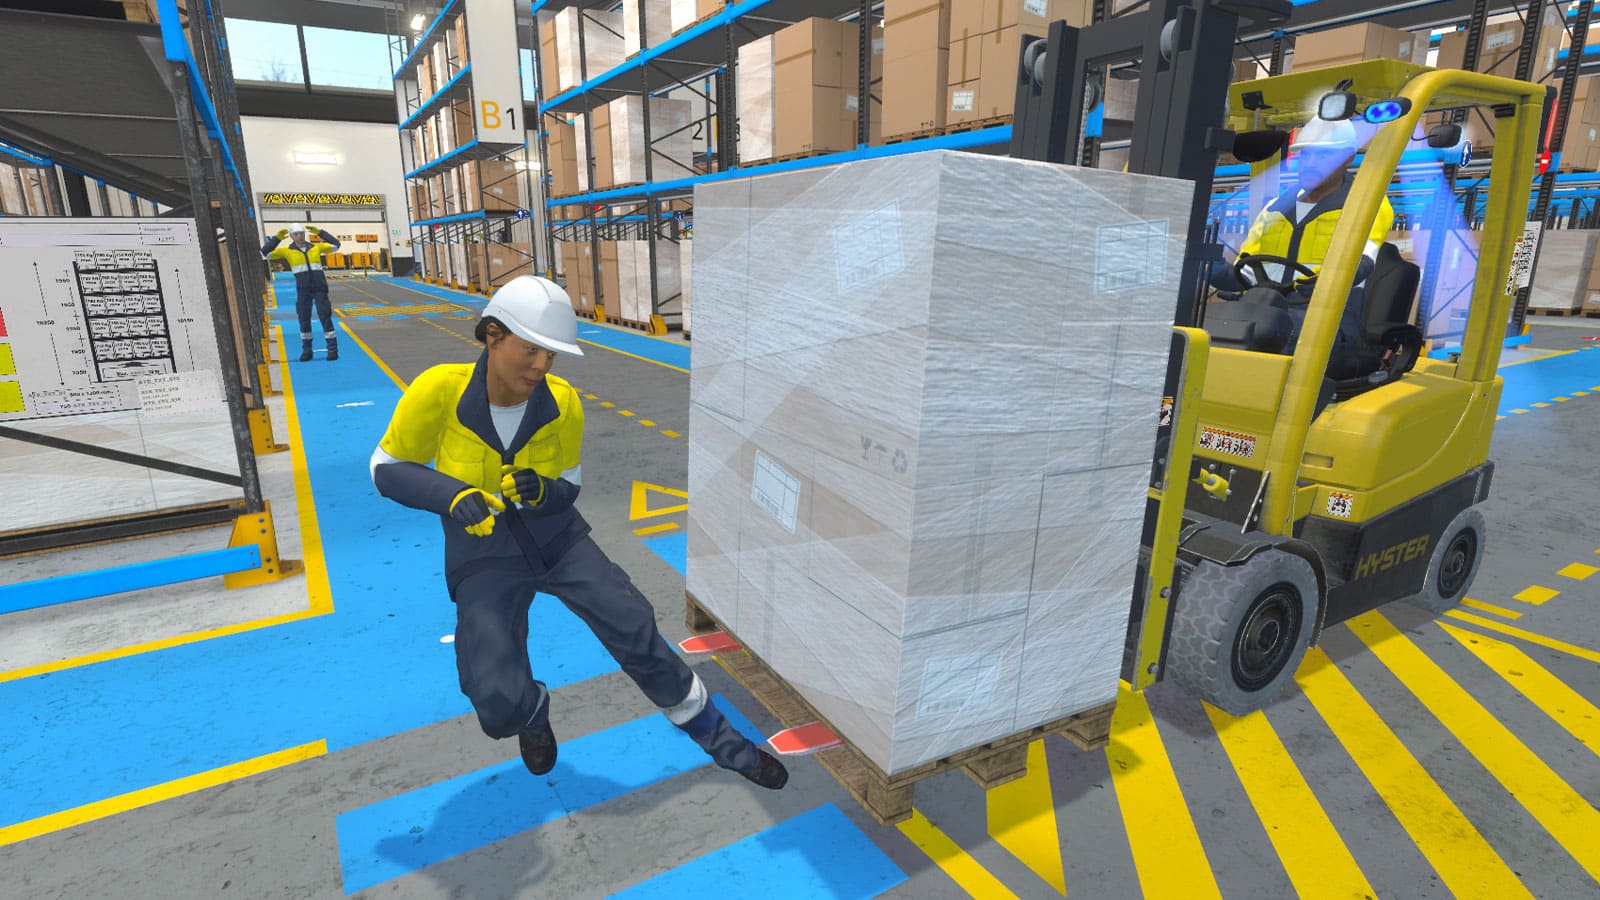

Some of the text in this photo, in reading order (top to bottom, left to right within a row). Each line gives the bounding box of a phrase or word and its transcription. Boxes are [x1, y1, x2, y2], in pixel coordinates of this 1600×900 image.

[481, 100, 516, 131] B 1
[692, 120, 703, 140] 2
[1354, 534, 1431, 581] HYSTER
